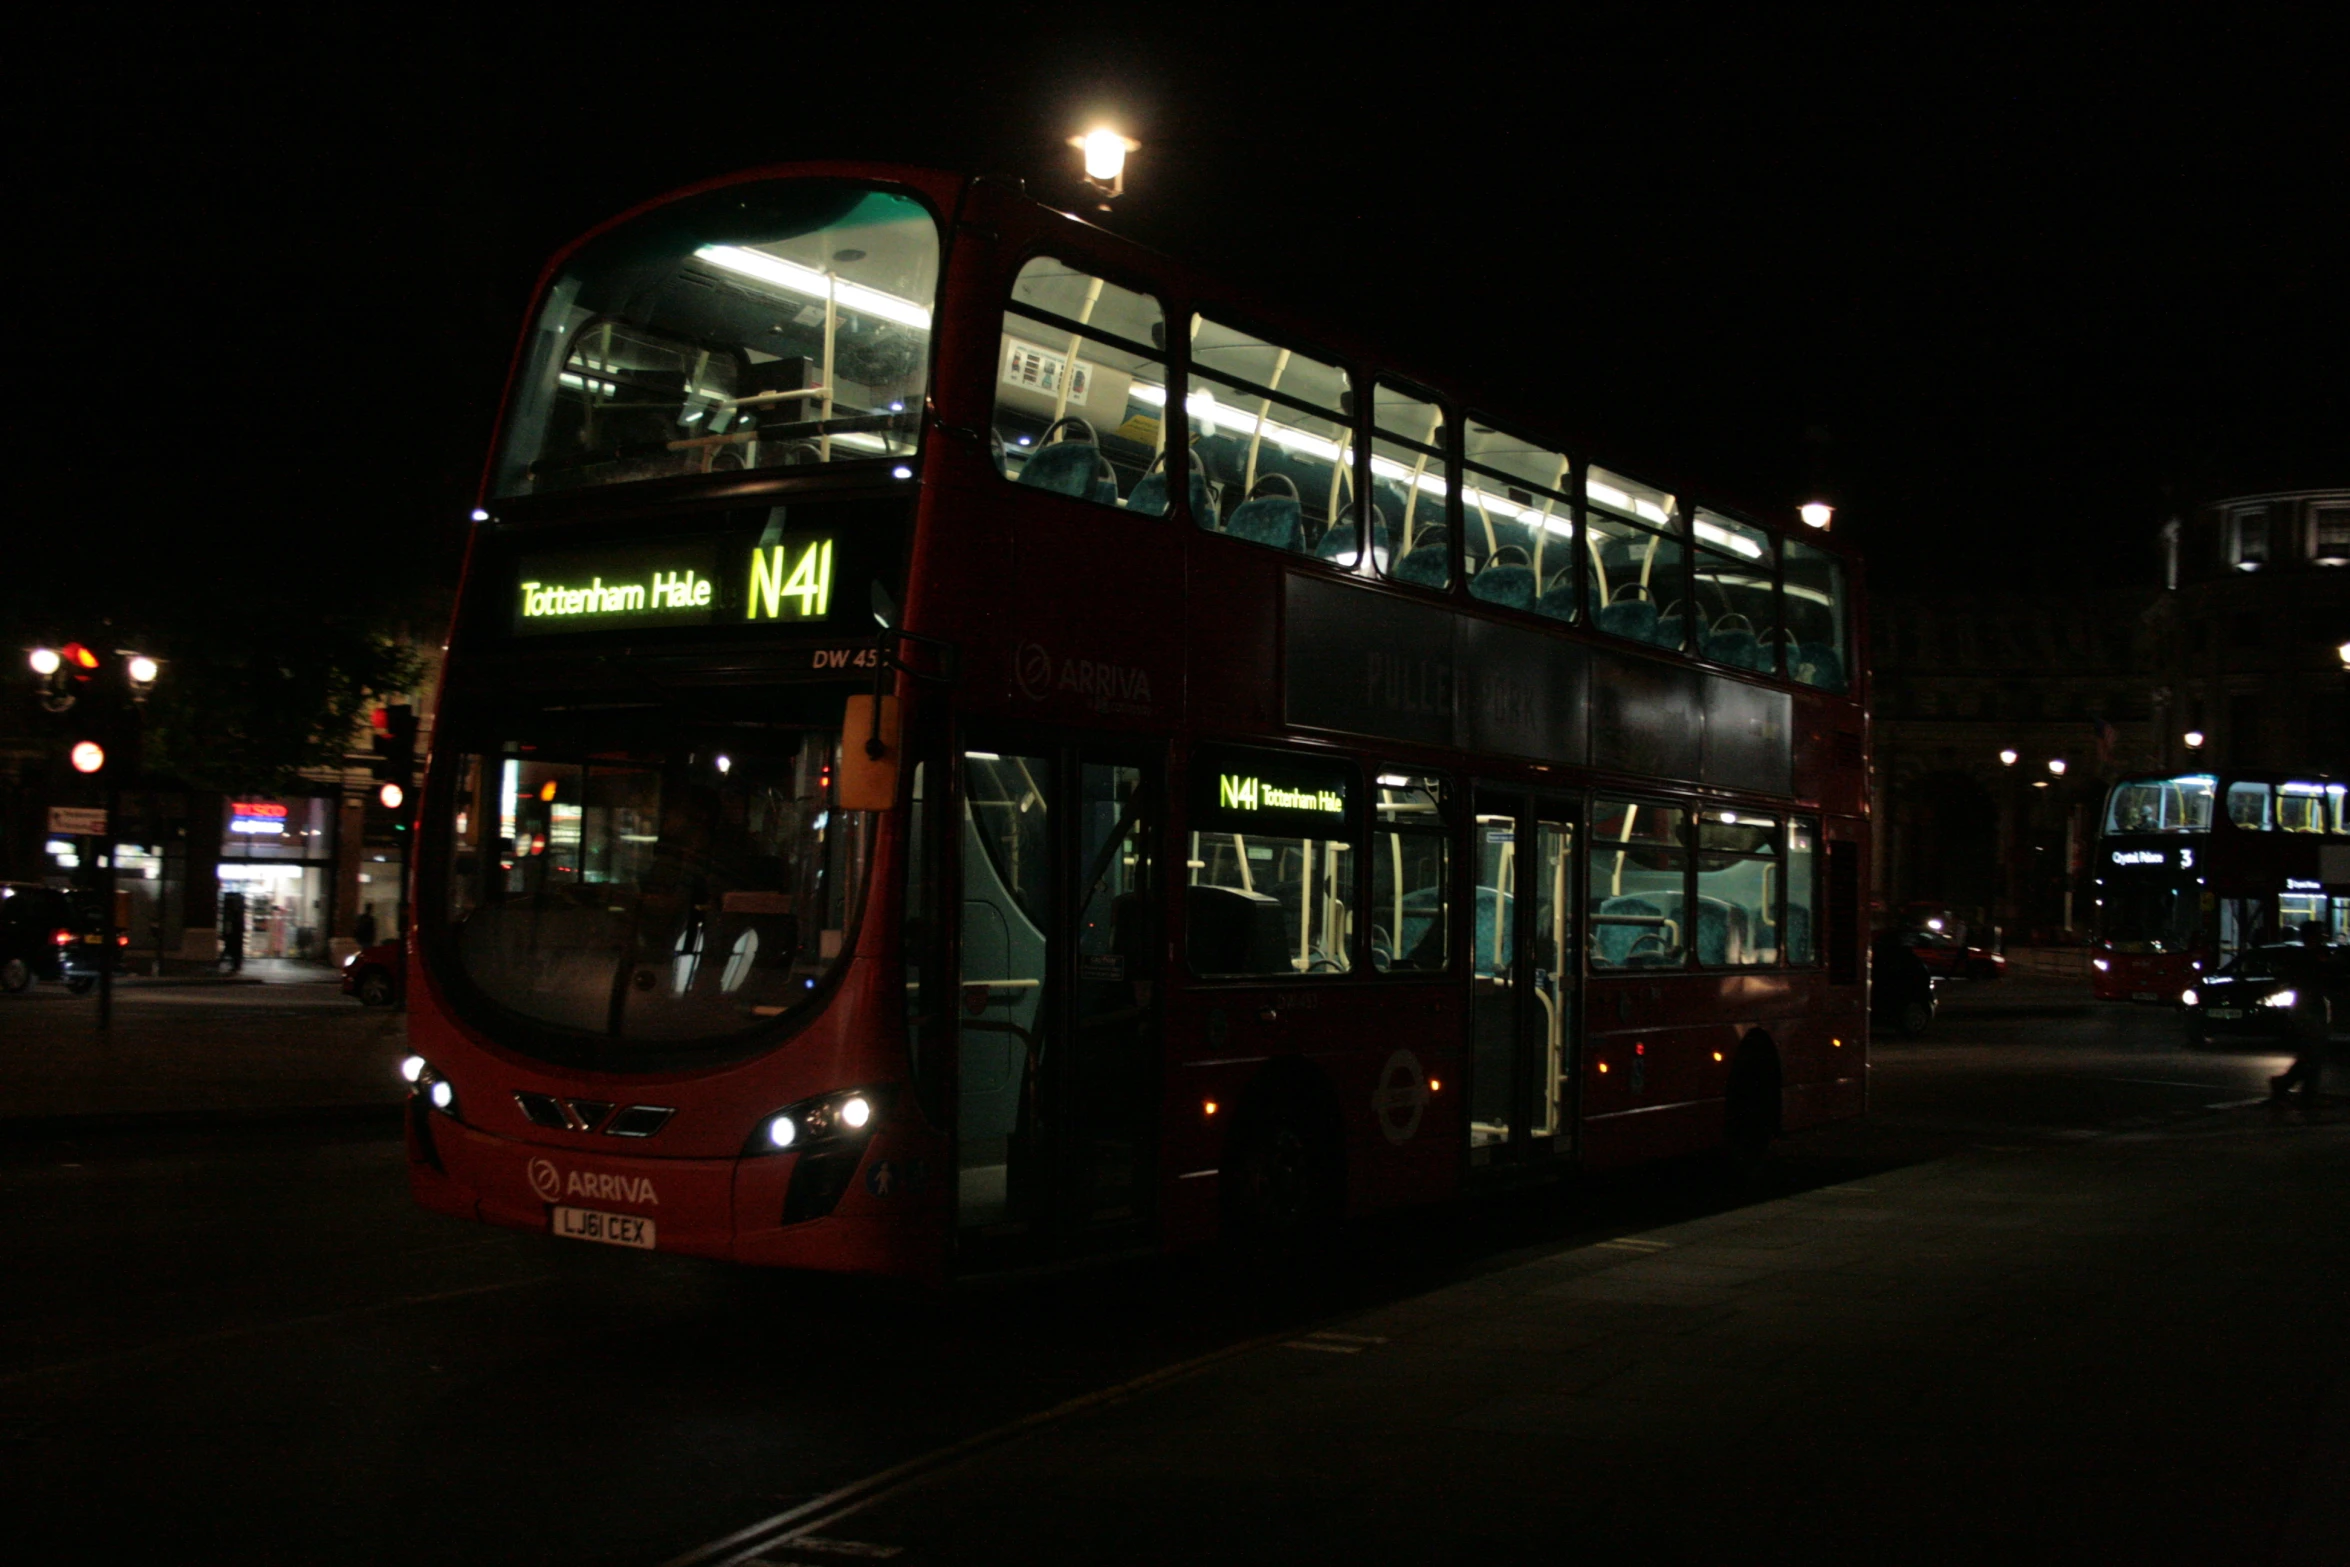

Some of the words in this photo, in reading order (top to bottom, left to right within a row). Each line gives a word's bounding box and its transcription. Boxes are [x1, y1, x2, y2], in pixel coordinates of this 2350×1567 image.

[521, 577, 645, 616] Tottenham
[651, 569, 711, 608] Hale
[748, 539, 832, 619] N41
[813, 648, 851, 669] DW
[1058, 658, 1152, 702] ARRIVA
[1220, 773, 1258, 811] N41
[1261, 784, 1317, 810] Tottenham
[1319, 790, 1342, 812] Hale
[2179, 848, 2193, 868] 3
[566, 1169, 660, 1205] ARRIVA
[564, 1209, 603, 1238] LJ61
[608, 1217, 645, 1244] CEX
